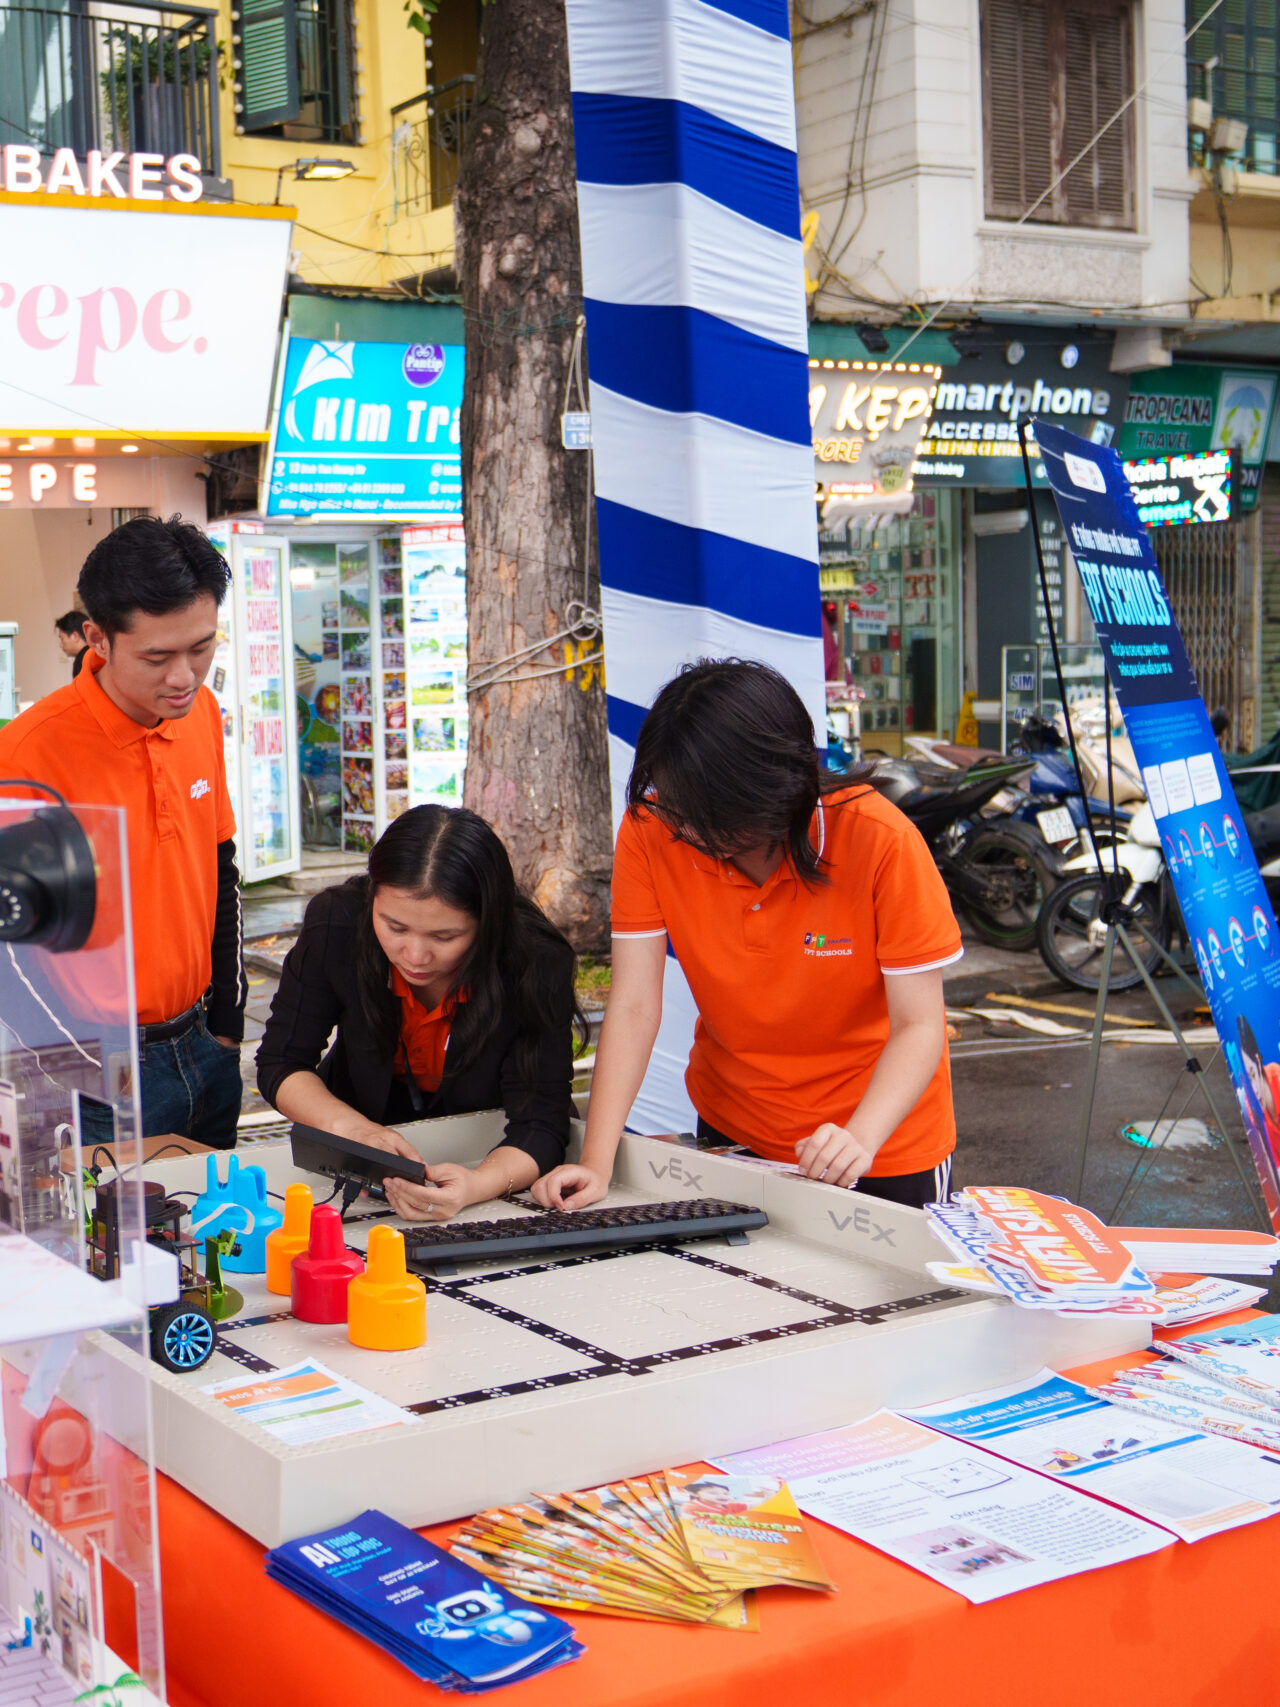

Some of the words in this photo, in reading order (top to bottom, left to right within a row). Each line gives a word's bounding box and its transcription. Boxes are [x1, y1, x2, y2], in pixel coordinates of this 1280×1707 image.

[406, 356, 444, 372] Pantip
[835, 382, 929, 441] KẸP
[935, 379, 1111, 421] martphone
[1124, 394, 1212, 425] TROPICANA
[312, 397, 391, 442] Kim
[813, 437, 864, 463] PORE
[1137, 430, 1191, 449] TRAVEL
[1123, 463, 1168, 484] hone
[1170, 455, 1229, 479] Repair
[1138, 501, 1192, 523] ement
[1077, 560, 1112, 624] FPT
[1101, 565, 1171, 626] SCHOOLS
[1010, 673, 1033, 690] SIM
[804, 932, 826, 947] FPT
[816, 949, 853, 957] SCHOOLS
[648, 1157, 704, 1191] VEX
[827, 1207, 897, 1248] VEX
[1061, 1213, 1099, 1240] SCHOOLS
[299, 1542, 342, 1569] AI
